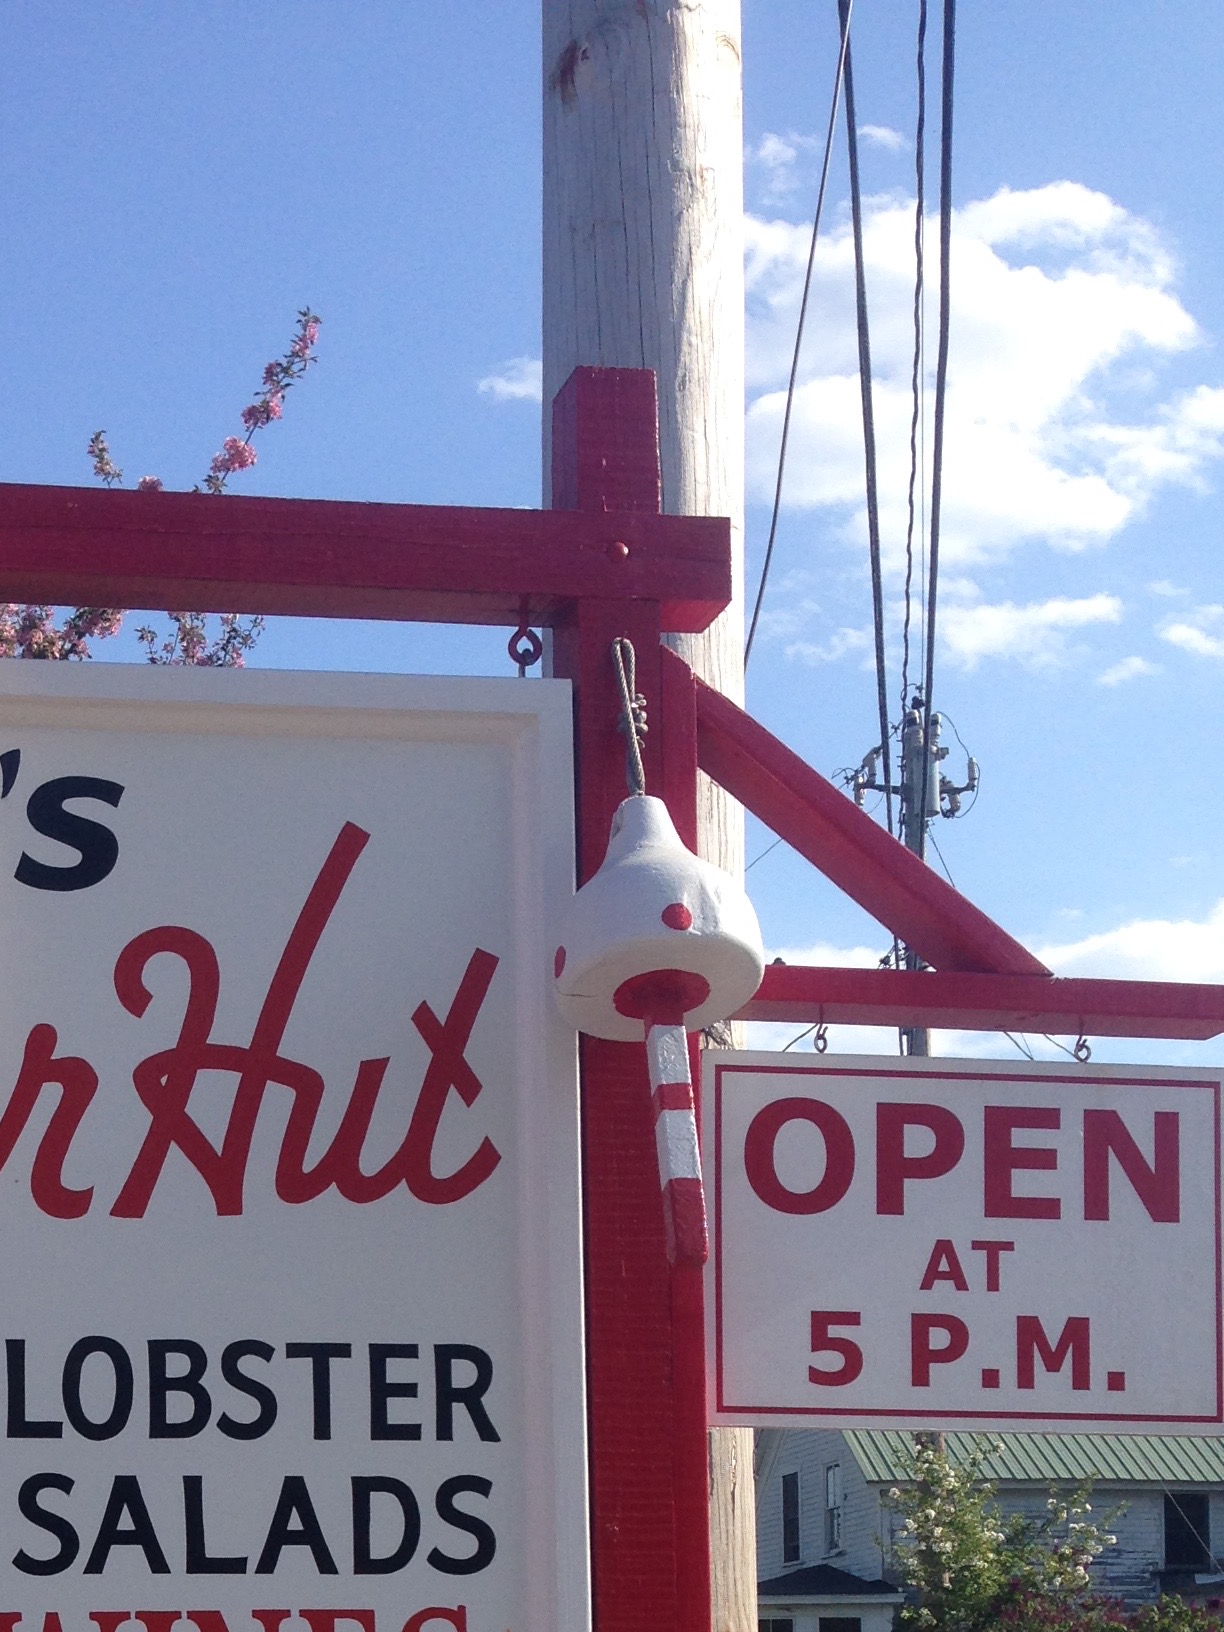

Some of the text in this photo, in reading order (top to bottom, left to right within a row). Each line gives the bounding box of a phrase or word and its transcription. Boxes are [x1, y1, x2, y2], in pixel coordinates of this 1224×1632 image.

[110, 820, 502, 1218] Hut
[744, 1097, 1180, 1222] OPEN
[919, 1239, 1014, 1292] AT
[6, 1336, 501, 1442] LOBSTER
[808, 1311, 1125, 1391] 5 P.M.
[12, 1473, 497, 1577] SALADS
